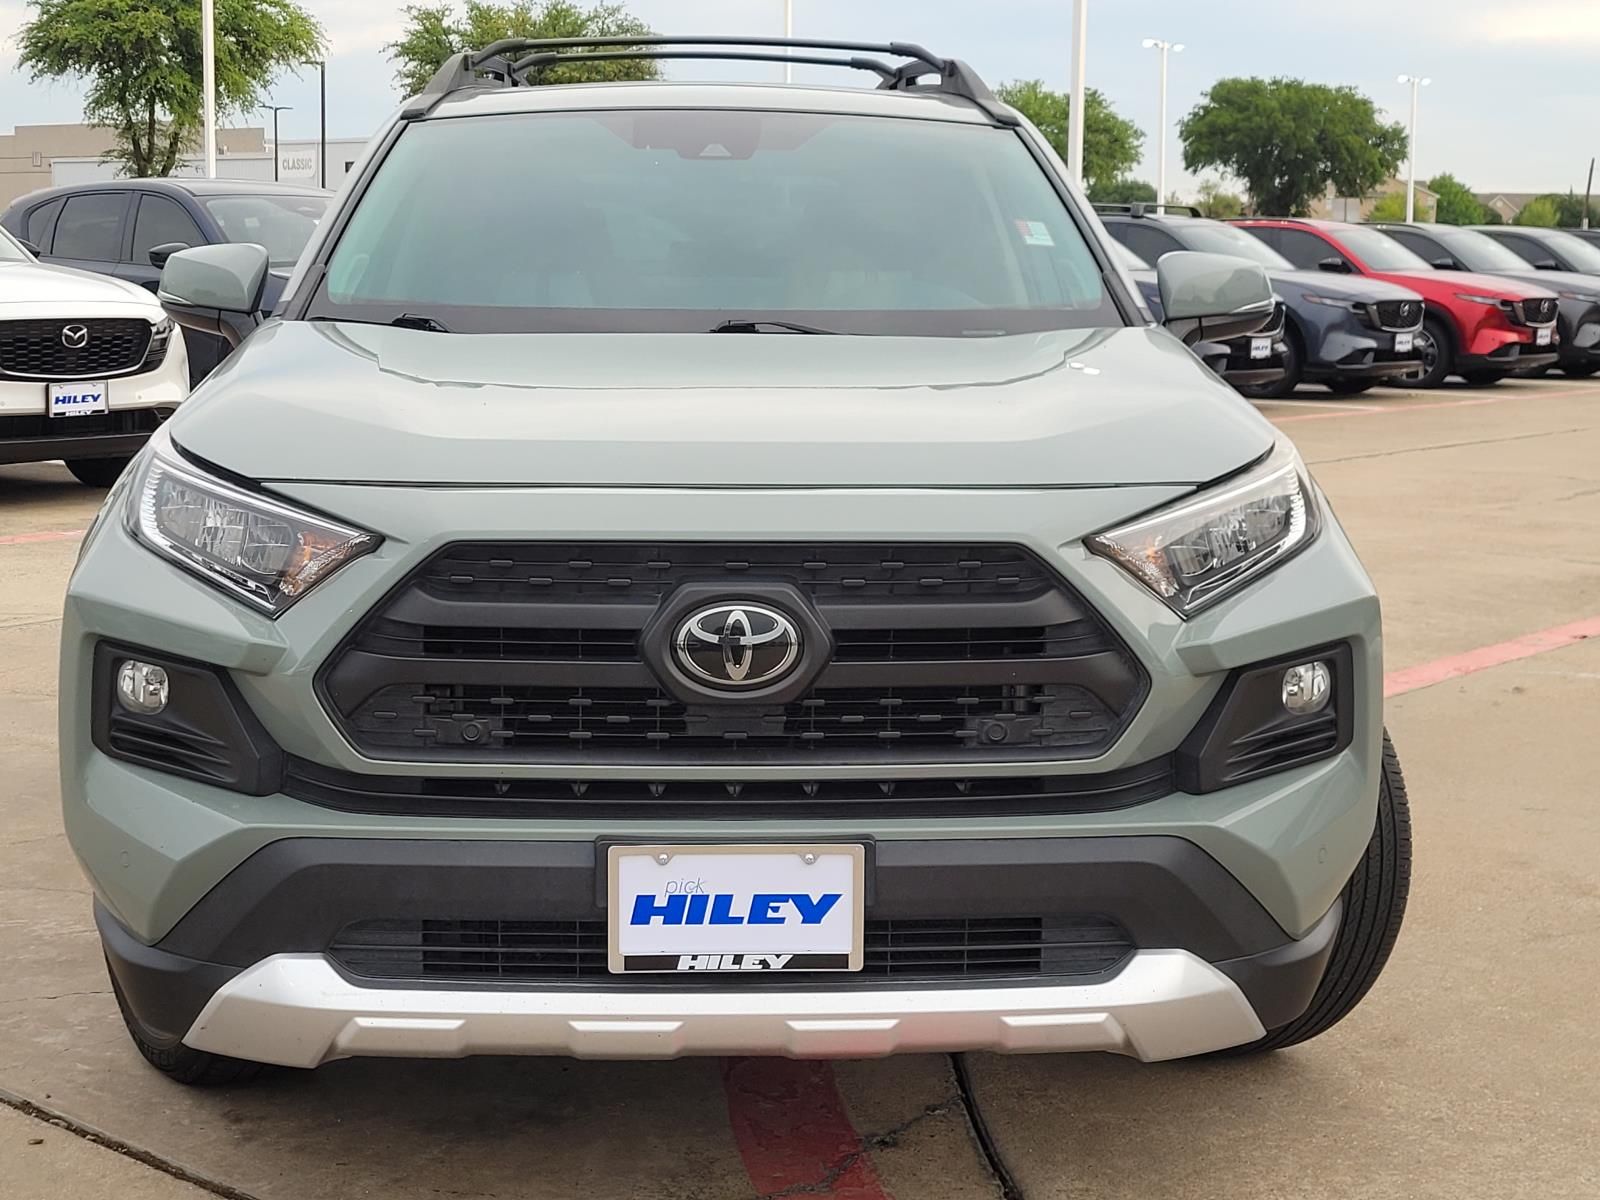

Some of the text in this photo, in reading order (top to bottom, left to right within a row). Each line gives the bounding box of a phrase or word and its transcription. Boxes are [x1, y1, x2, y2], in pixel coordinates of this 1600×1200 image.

[282, 158, 313, 170] CLASSIC
[54, 394, 101, 404] HILEY
[664, 877, 706, 896] pick
[630, 894, 843, 925] HILEY
[676, 954, 794, 971] HILEY
